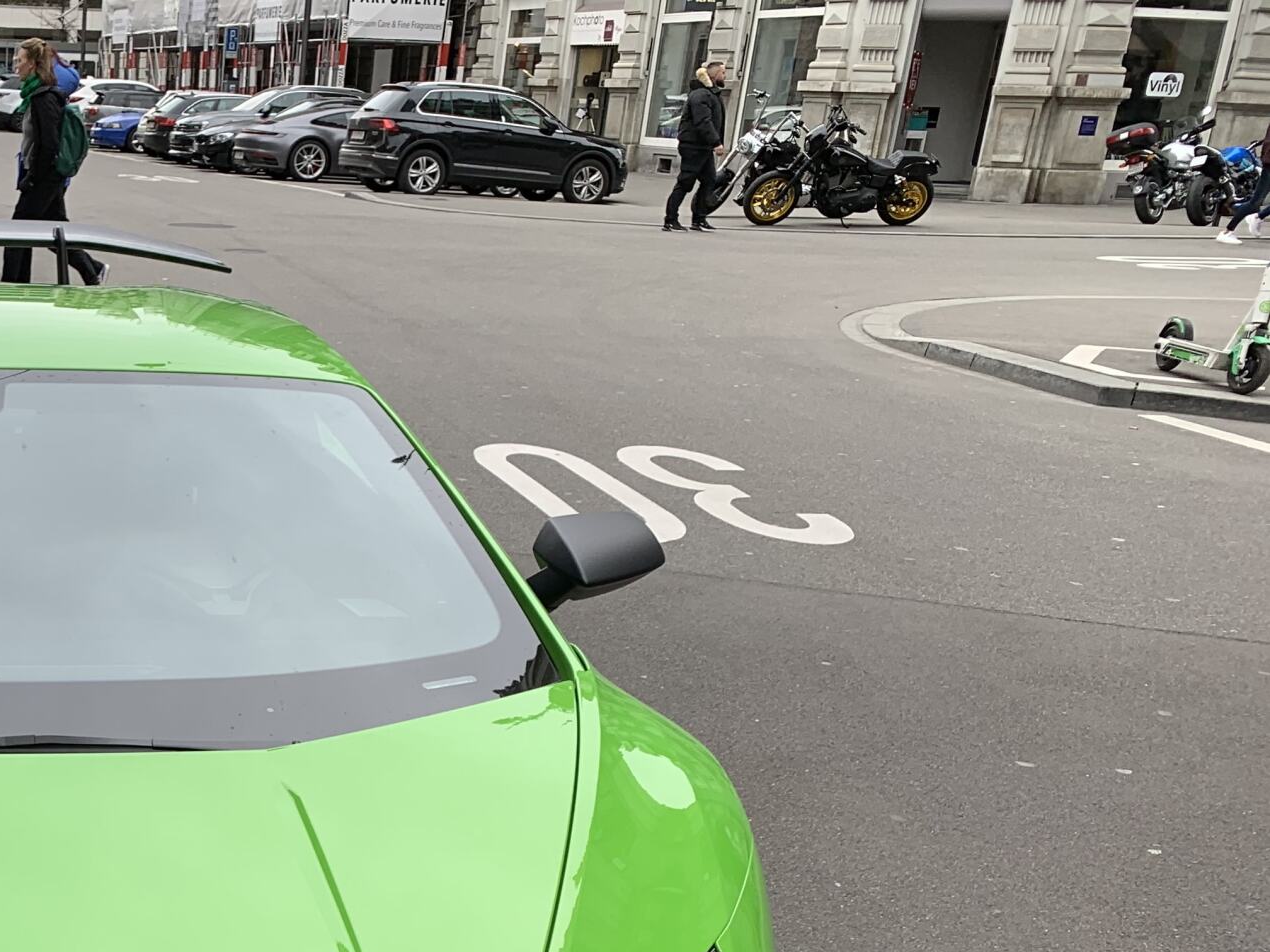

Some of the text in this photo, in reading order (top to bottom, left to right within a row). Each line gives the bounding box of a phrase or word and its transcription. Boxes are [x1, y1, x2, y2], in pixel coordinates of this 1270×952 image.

[377, 19, 391, 28] Care
[397, 20, 411, 29] Fine
[411, 20, 442, 32] Fragrances
[1150, 79, 1180, 96] Vinyl
